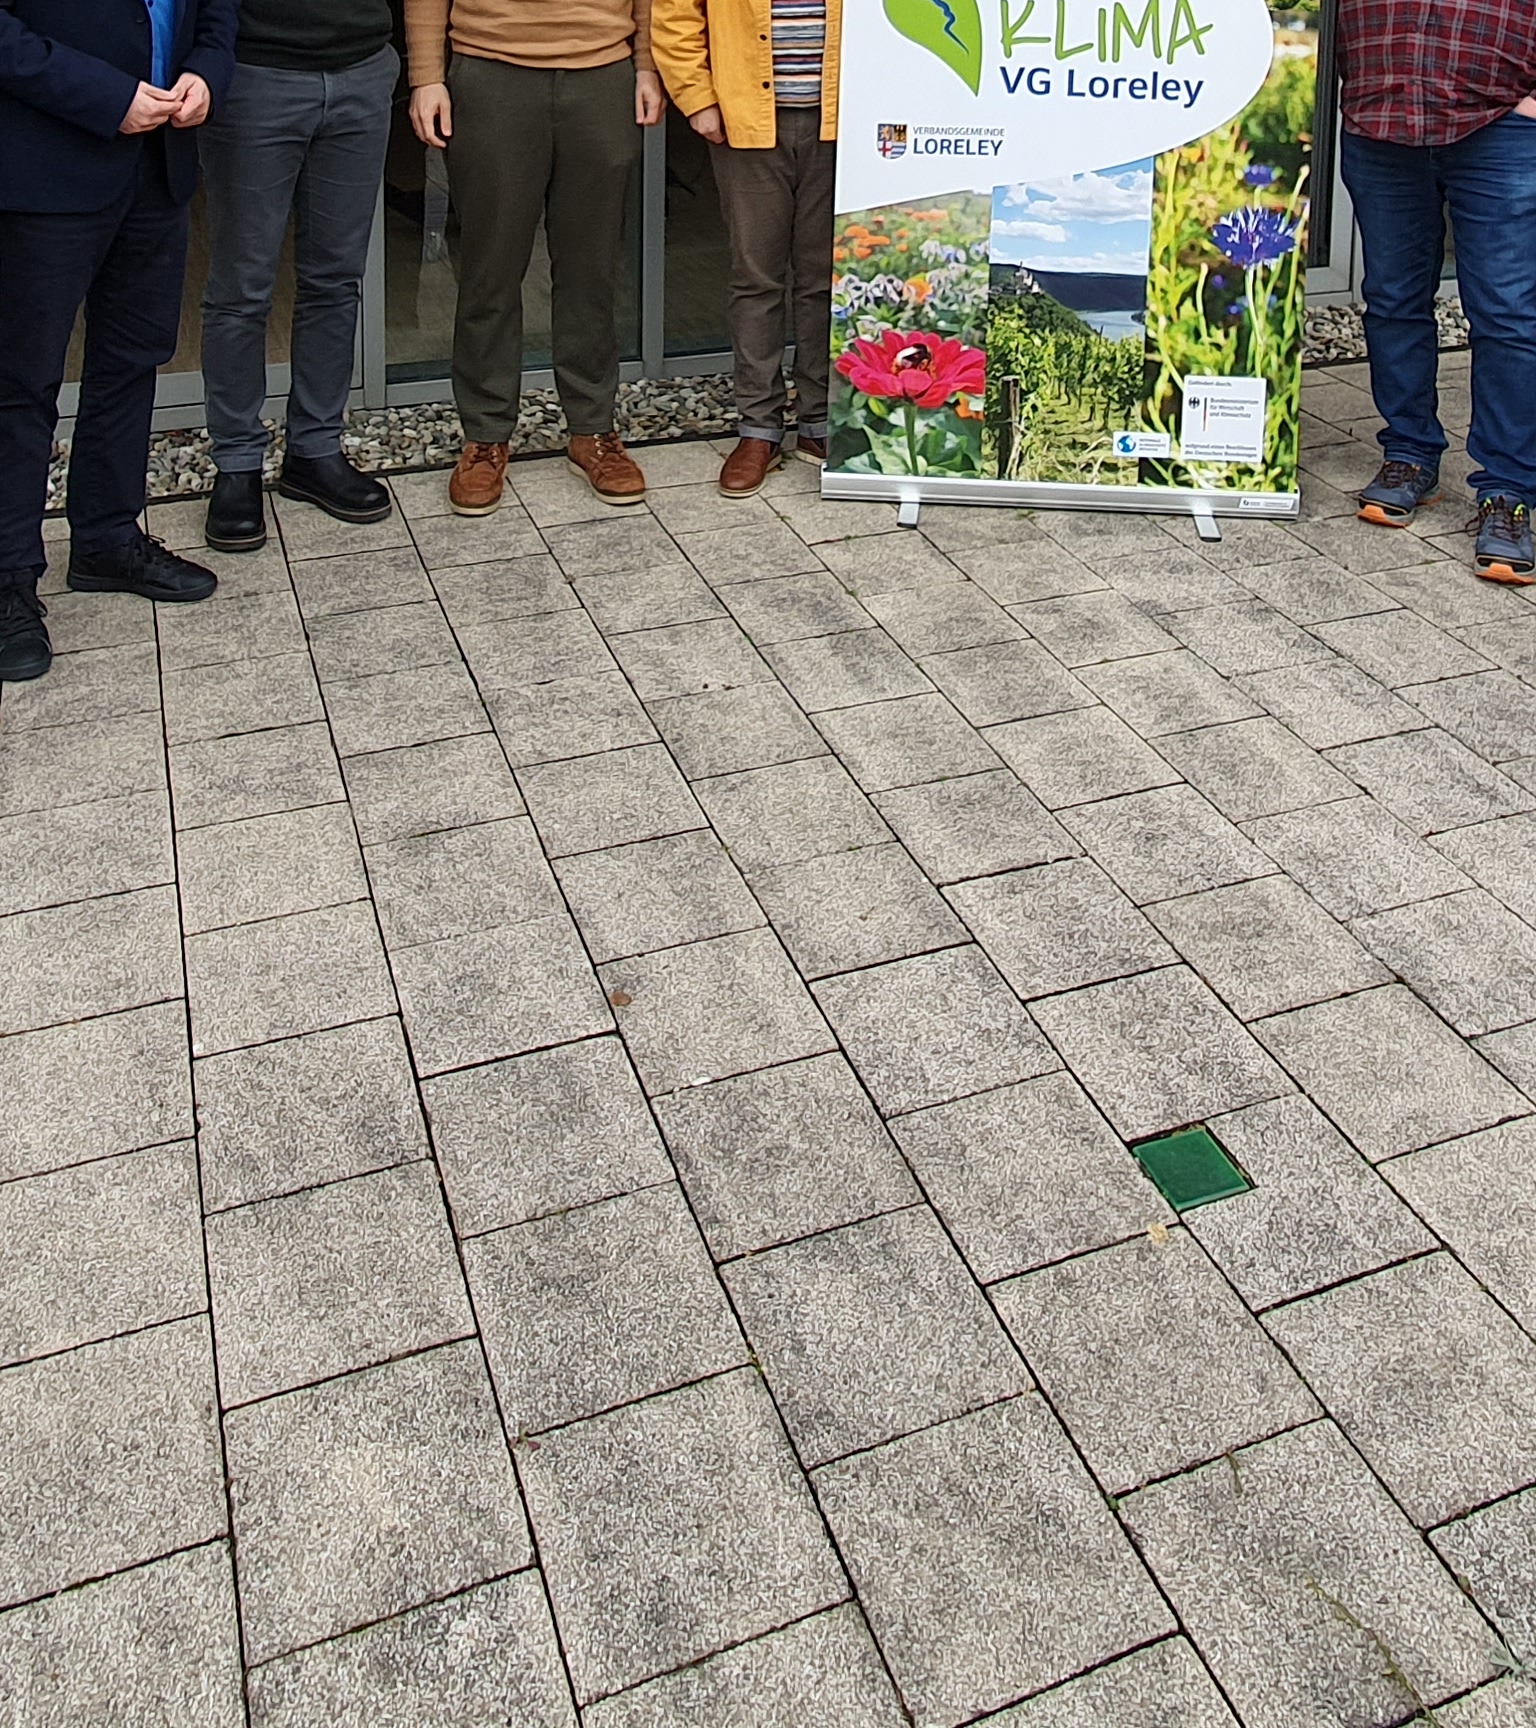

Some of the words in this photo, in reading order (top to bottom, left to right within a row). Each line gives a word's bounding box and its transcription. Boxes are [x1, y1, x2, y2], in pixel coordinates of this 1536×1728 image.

[999, 66, 1051, 96] VG
[1067, 69, 1204, 109] Loreley
[912, 126, 1005, 137] VERBANDSGEMEINDE
[913, 137, 1004, 156] LORELEY
